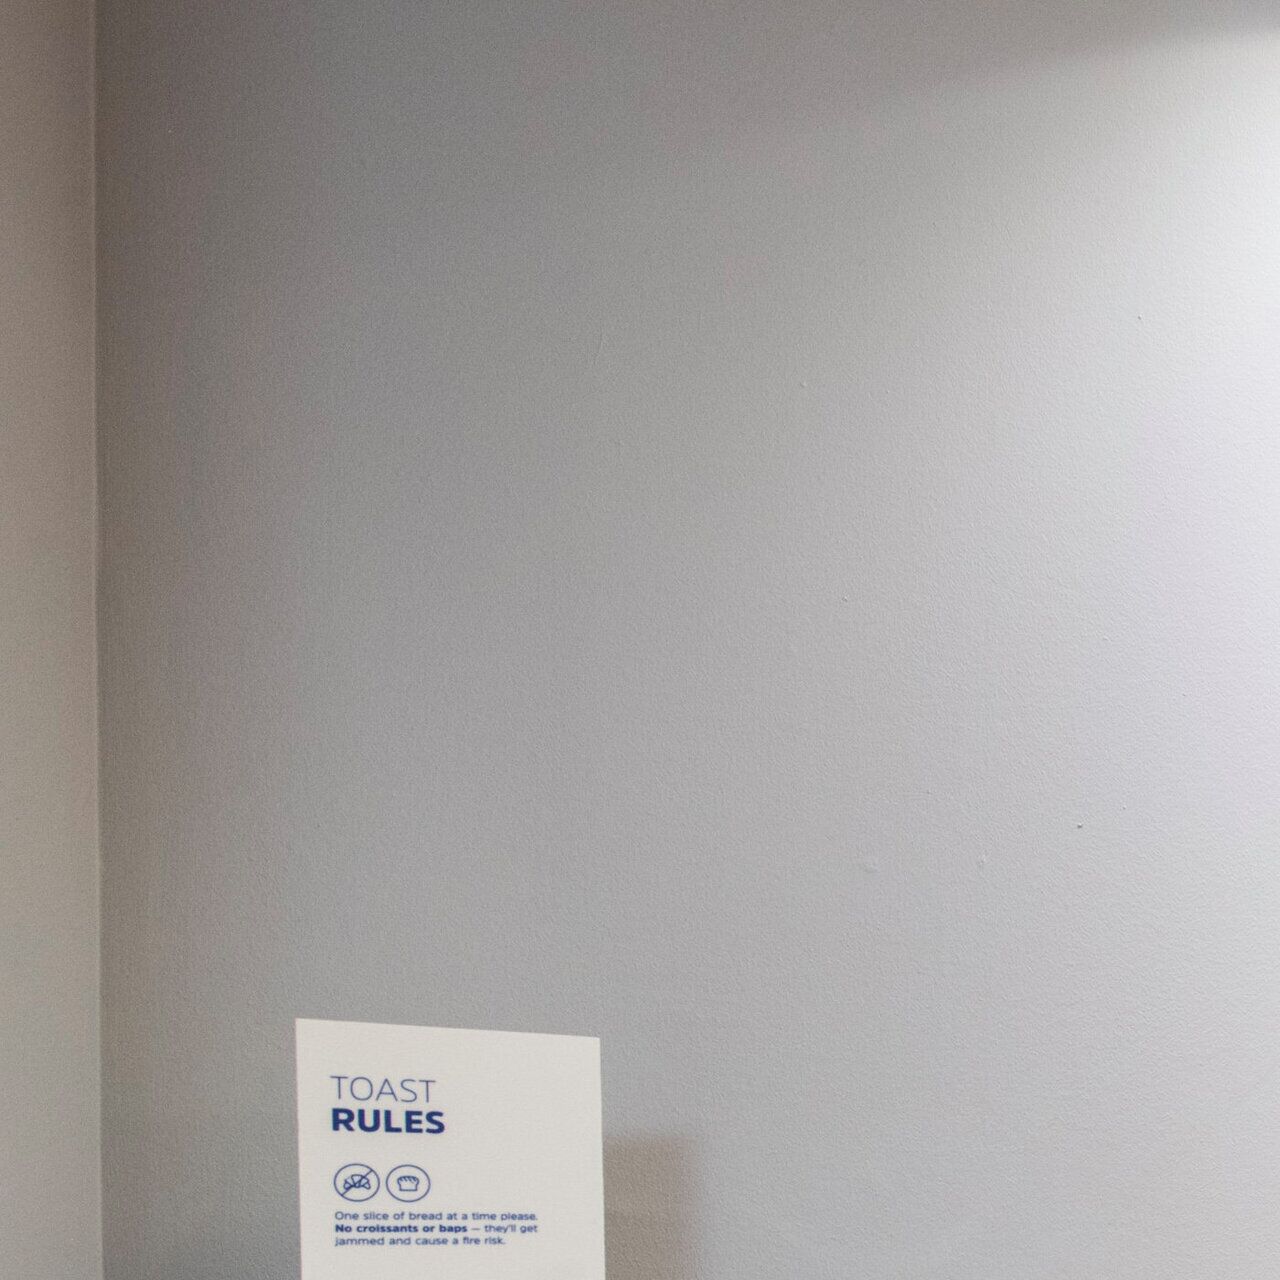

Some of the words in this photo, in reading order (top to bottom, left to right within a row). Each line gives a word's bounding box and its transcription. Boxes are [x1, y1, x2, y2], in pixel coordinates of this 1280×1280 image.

[330, 1075, 437, 1103] TOAST
[331, 1107, 446, 1135] RULES
[335, 1211, 359, 1221] One
[363, 1211, 389, 1221] slice
[393, 1211, 405, 1221] of
[408, 1211, 443, 1221] bread
[446, 1212, 458, 1221] at
[461, 1213, 468, 1221] a
[472, 1211, 497, 1221] time
[500, 1212, 538, 1224] please.
[335, 1224, 352, 1233] No
[356, 1224, 419, 1233] croissants
[422, 1225, 435, 1233] or
[439, 1224, 468, 1235] baps
[484, 1224, 517, 1234] they'll
[520, 1225, 538, 1234] get
[334, 1237, 385, 1247] jammed
[388, 1237, 411, 1246] and
[415, 1238, 449, 1246] cause
[452, 1238, 459, 1246] a
[463, 1236, 480, 1246] fire
[484, 1236, 506, 1246] risk.
